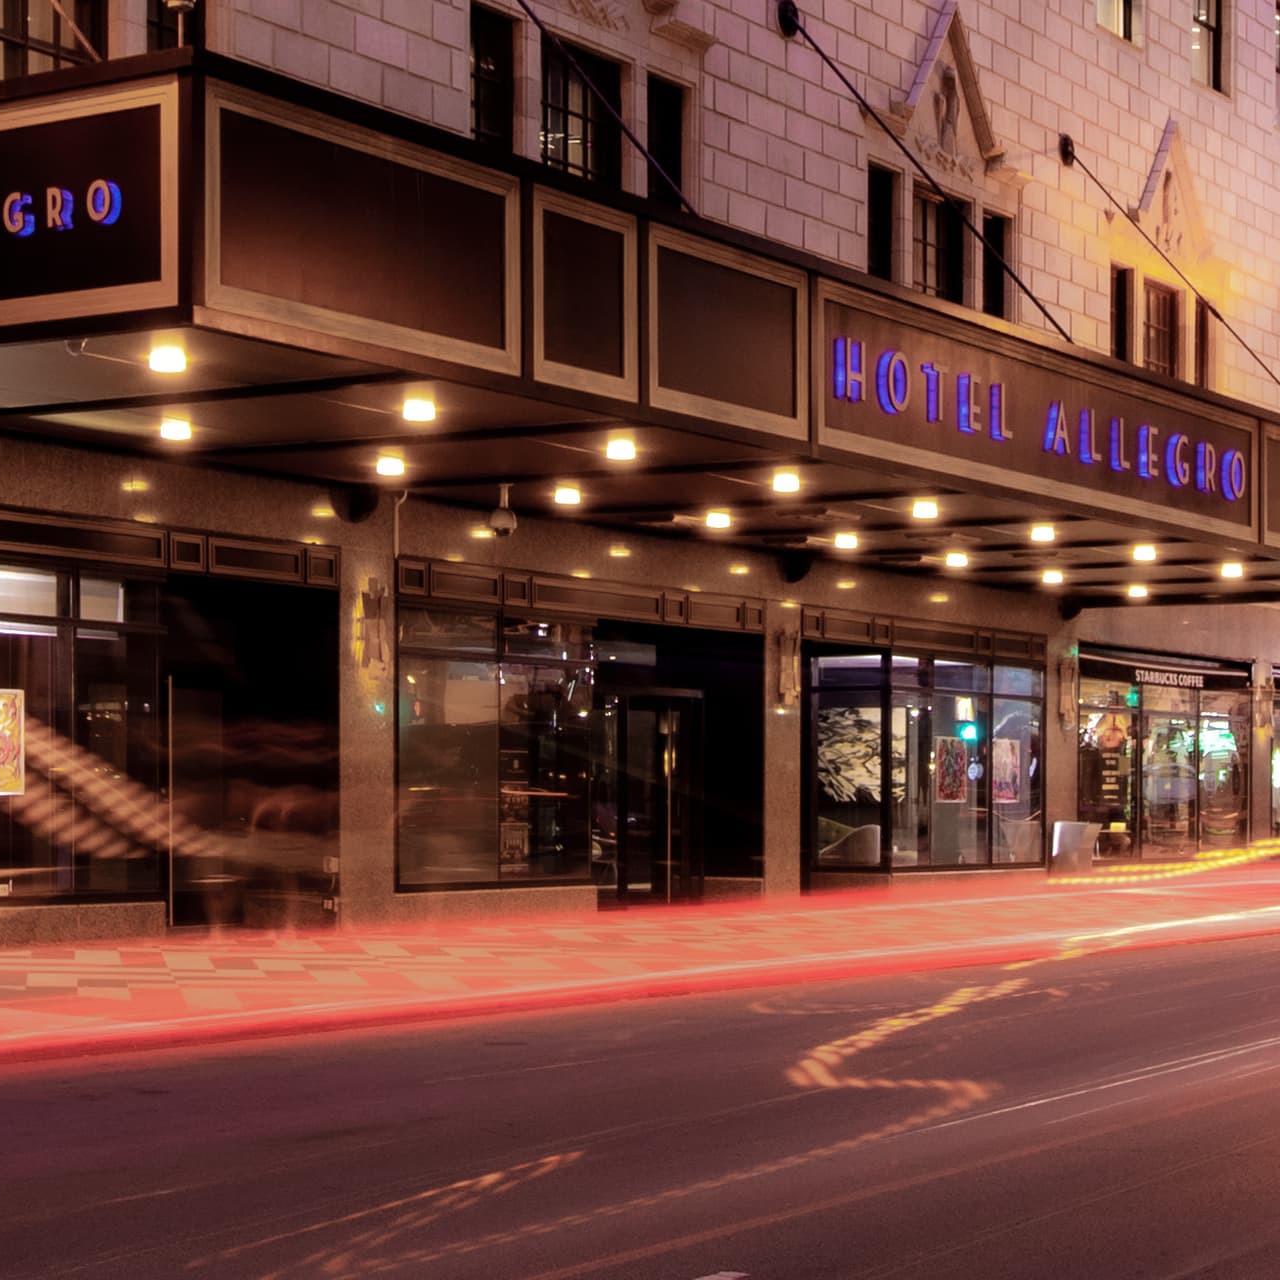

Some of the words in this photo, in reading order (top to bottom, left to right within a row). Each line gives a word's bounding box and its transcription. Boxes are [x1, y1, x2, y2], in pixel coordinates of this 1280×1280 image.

[833, 335, 1014, 442] HOTEL
[1043, 399, 1247, 502] ALLEGRO
[1135, 669, 1178, 686] STARBUCKS
[1178, 674, 1204, 688] COFFEE
